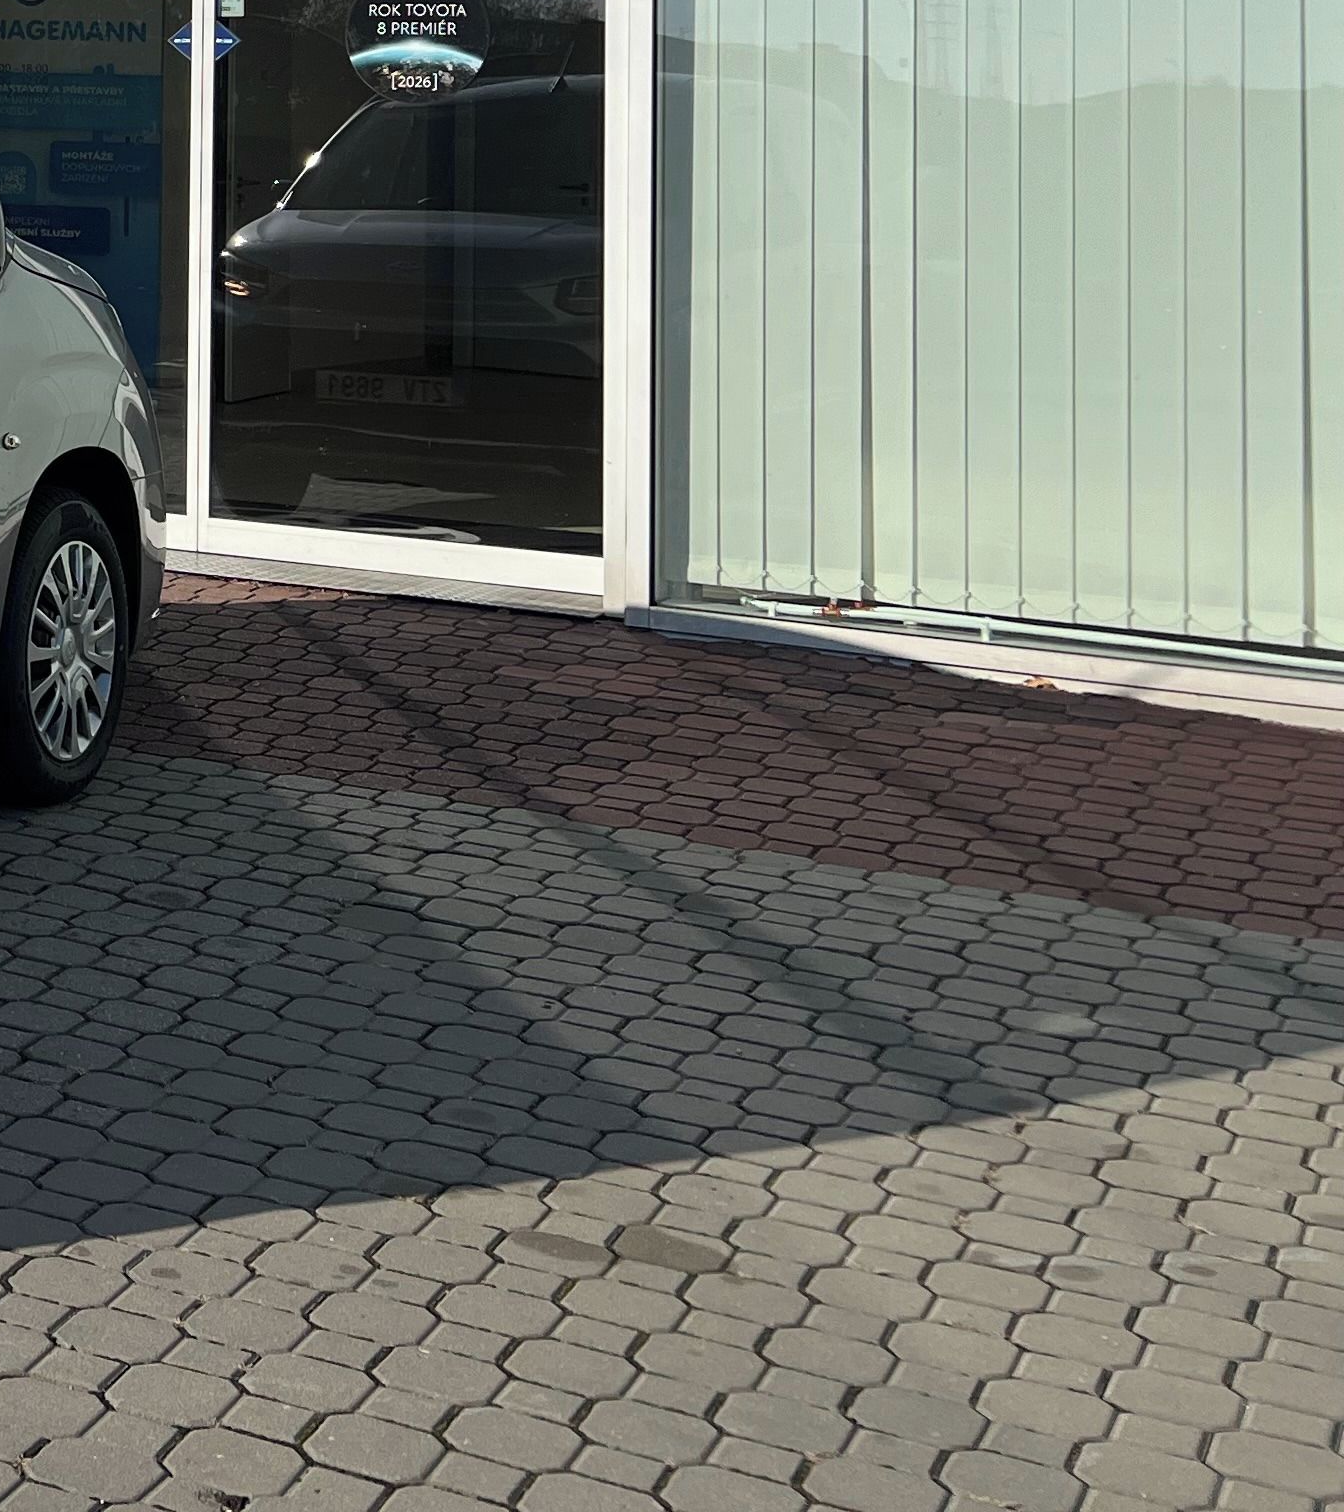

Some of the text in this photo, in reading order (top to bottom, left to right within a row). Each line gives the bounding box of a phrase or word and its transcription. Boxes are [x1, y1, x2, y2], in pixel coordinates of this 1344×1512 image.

[368, 3, 467, 17] ROK TOYOTA
[377, 19, 457, 36] 8 PREMIÉR
[61, 149, 114, 161] MONTÁŽE
[5, 215, 50, 226] MPLEXNÍ
[41, 228, 81, 238] SLUŽBY
